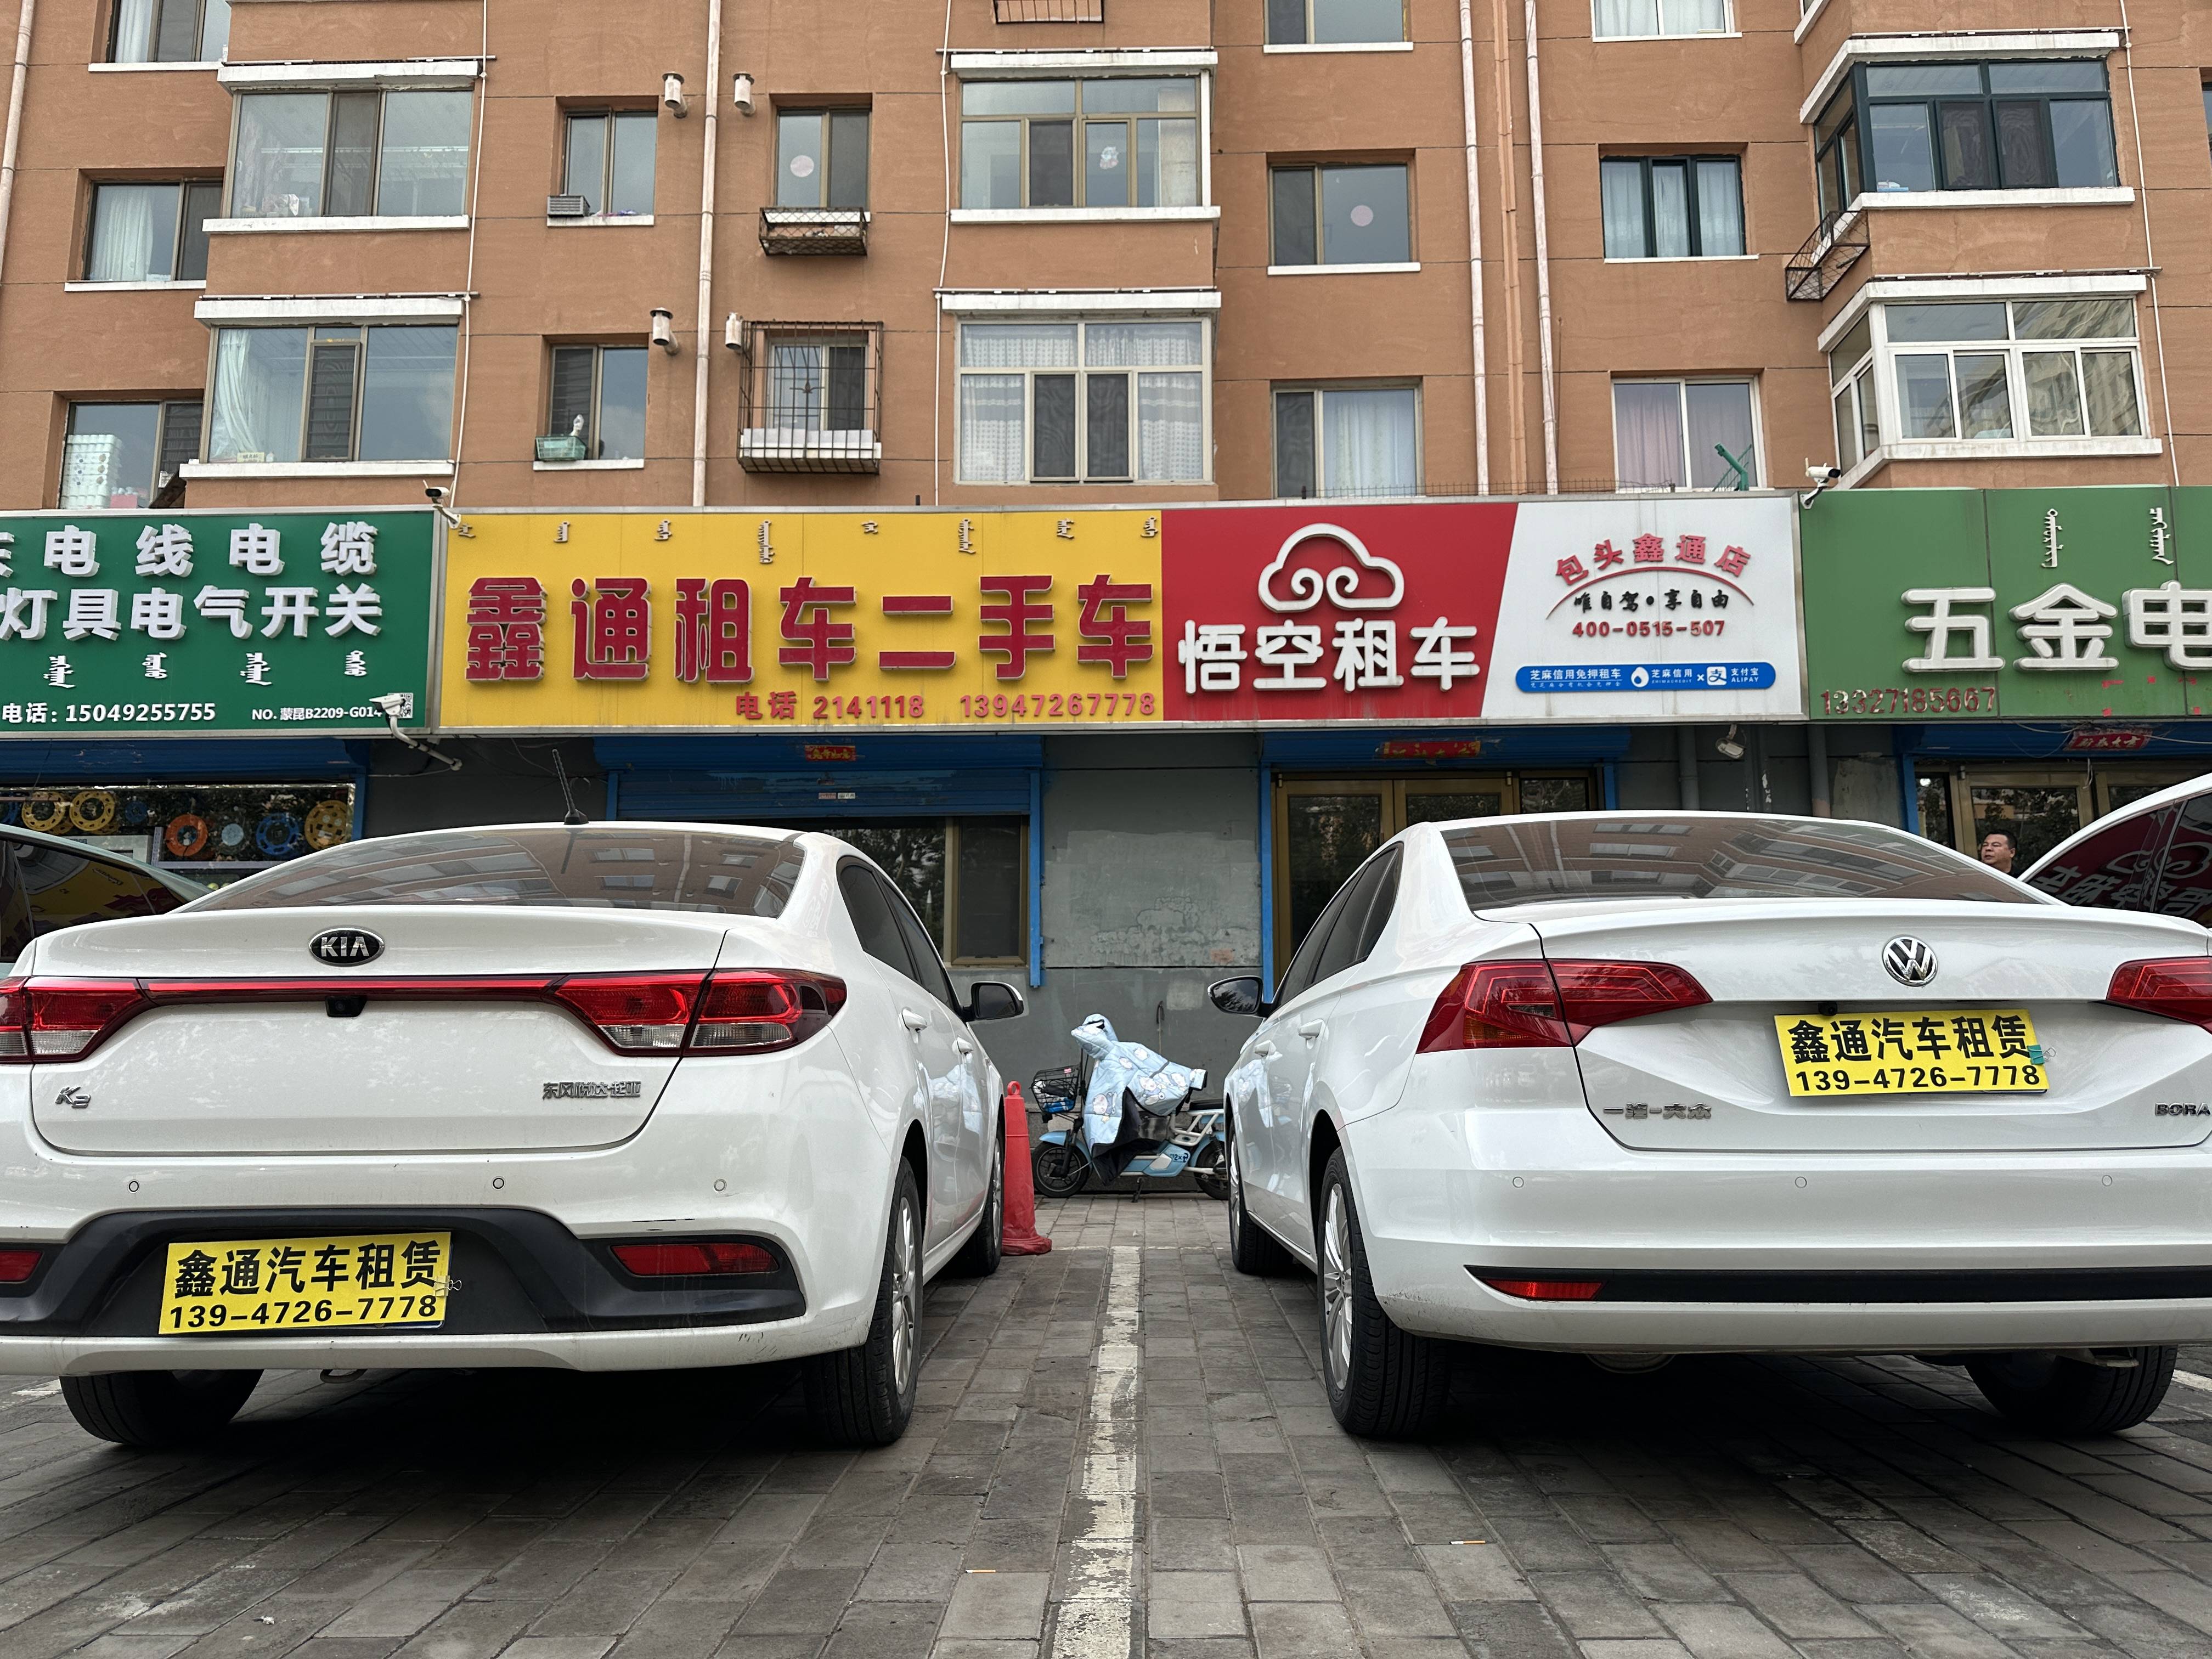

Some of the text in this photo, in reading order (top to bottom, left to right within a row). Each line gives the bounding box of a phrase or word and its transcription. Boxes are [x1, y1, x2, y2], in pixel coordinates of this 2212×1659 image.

[0, 522, 379, 578] 电线电缆
[1556, 533, 1751, 585] 包头鑫通店
[0, 583, 382, 641] 灯具电气开关
[1901, 580, 2212, 673] 五金电
[465, 574, 1154, 684] 鑫通租车二手车
[1572, 620, 1725, 637] 400-0515-507
[1178, 617, 1480, 696] 悟空租车
[1731, 667, 1759, 676] 支付宝
[1530, 668, 1622, 680] 芝麻信用免押租车
[1651, 668, 1692, 678] 芝麻信用
[736, 691, 1155, 719] 电话 2141118 13947267778
[1821, 686, 1996, 715] 13327185667
[321, 936, 370, 957] KIA
[1787, 1014, 2032, 1064] 鑫通汽车租赁
[1796, 1065, 2040, 1092] 139-4726-7778
[2155, 1102, 2210, 1116] BORA
[174, 1239, 441, 1299] 鑫通汽车租赁
[170, 1295, 437, 1329] 139-4726-7778
